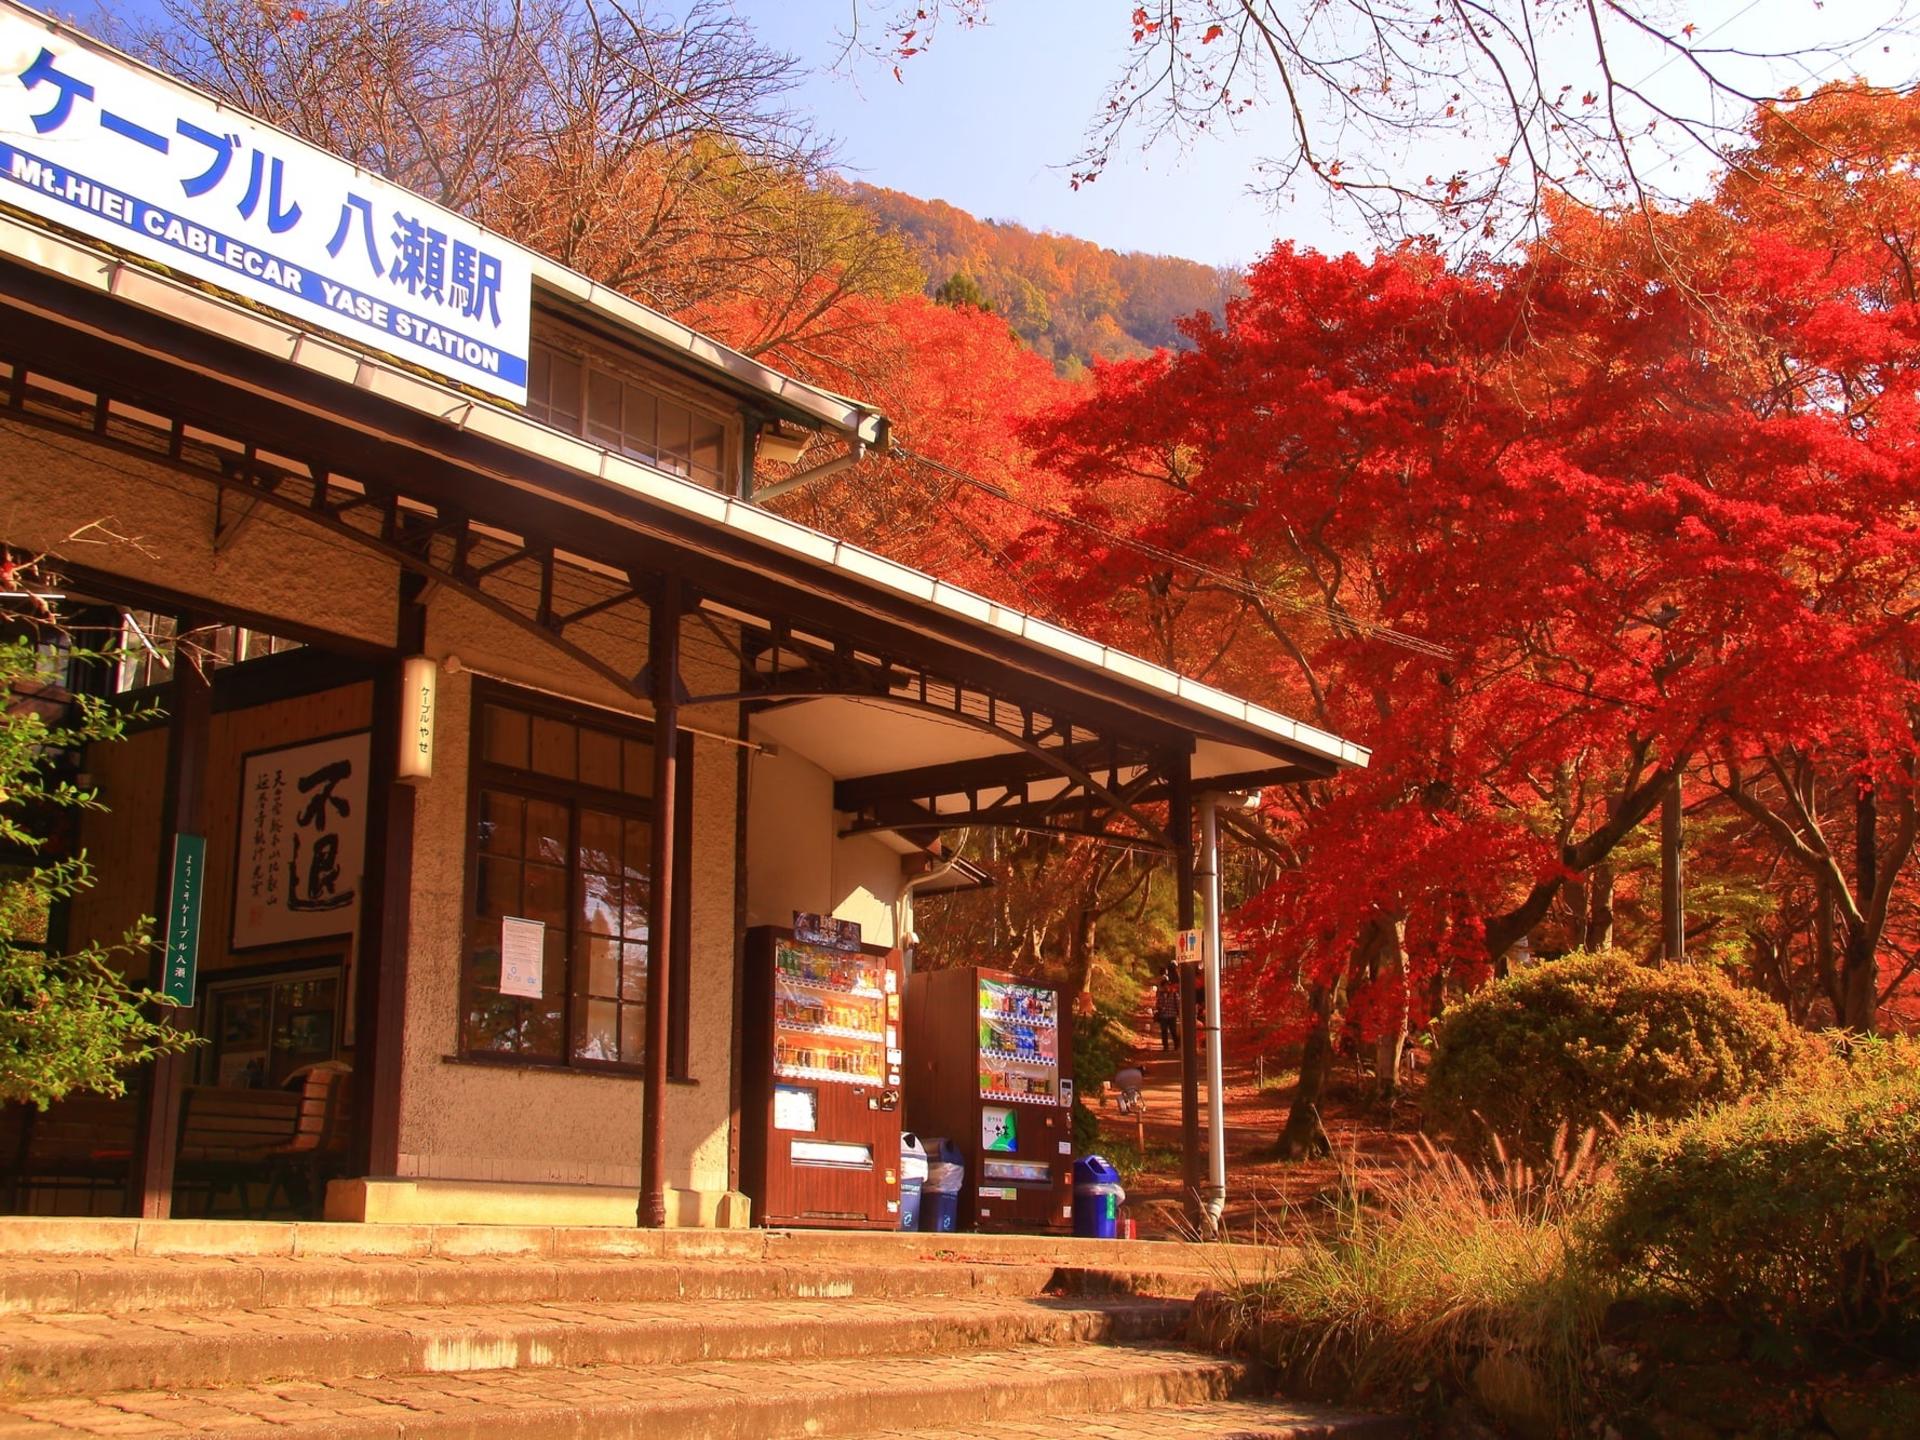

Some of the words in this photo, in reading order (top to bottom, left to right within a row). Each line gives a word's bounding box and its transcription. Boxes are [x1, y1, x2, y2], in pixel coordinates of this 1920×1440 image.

[12, 153, 134, 225] Mt.HIEI
[144, 210, 302, 294] CABLECAR
[321, 281, 389, 328] YASE
[395, 313, 500, 373] STATION
[18, 46, 303, 234] ケーブル
[326, 192, 502, 328] 八瀬駅
[418, 686, 431, 753] ケーブルやせ
[287, 758, 355, 912] 不退
[174, 854, 192, 988] ようこそケーブル八瀬へ
